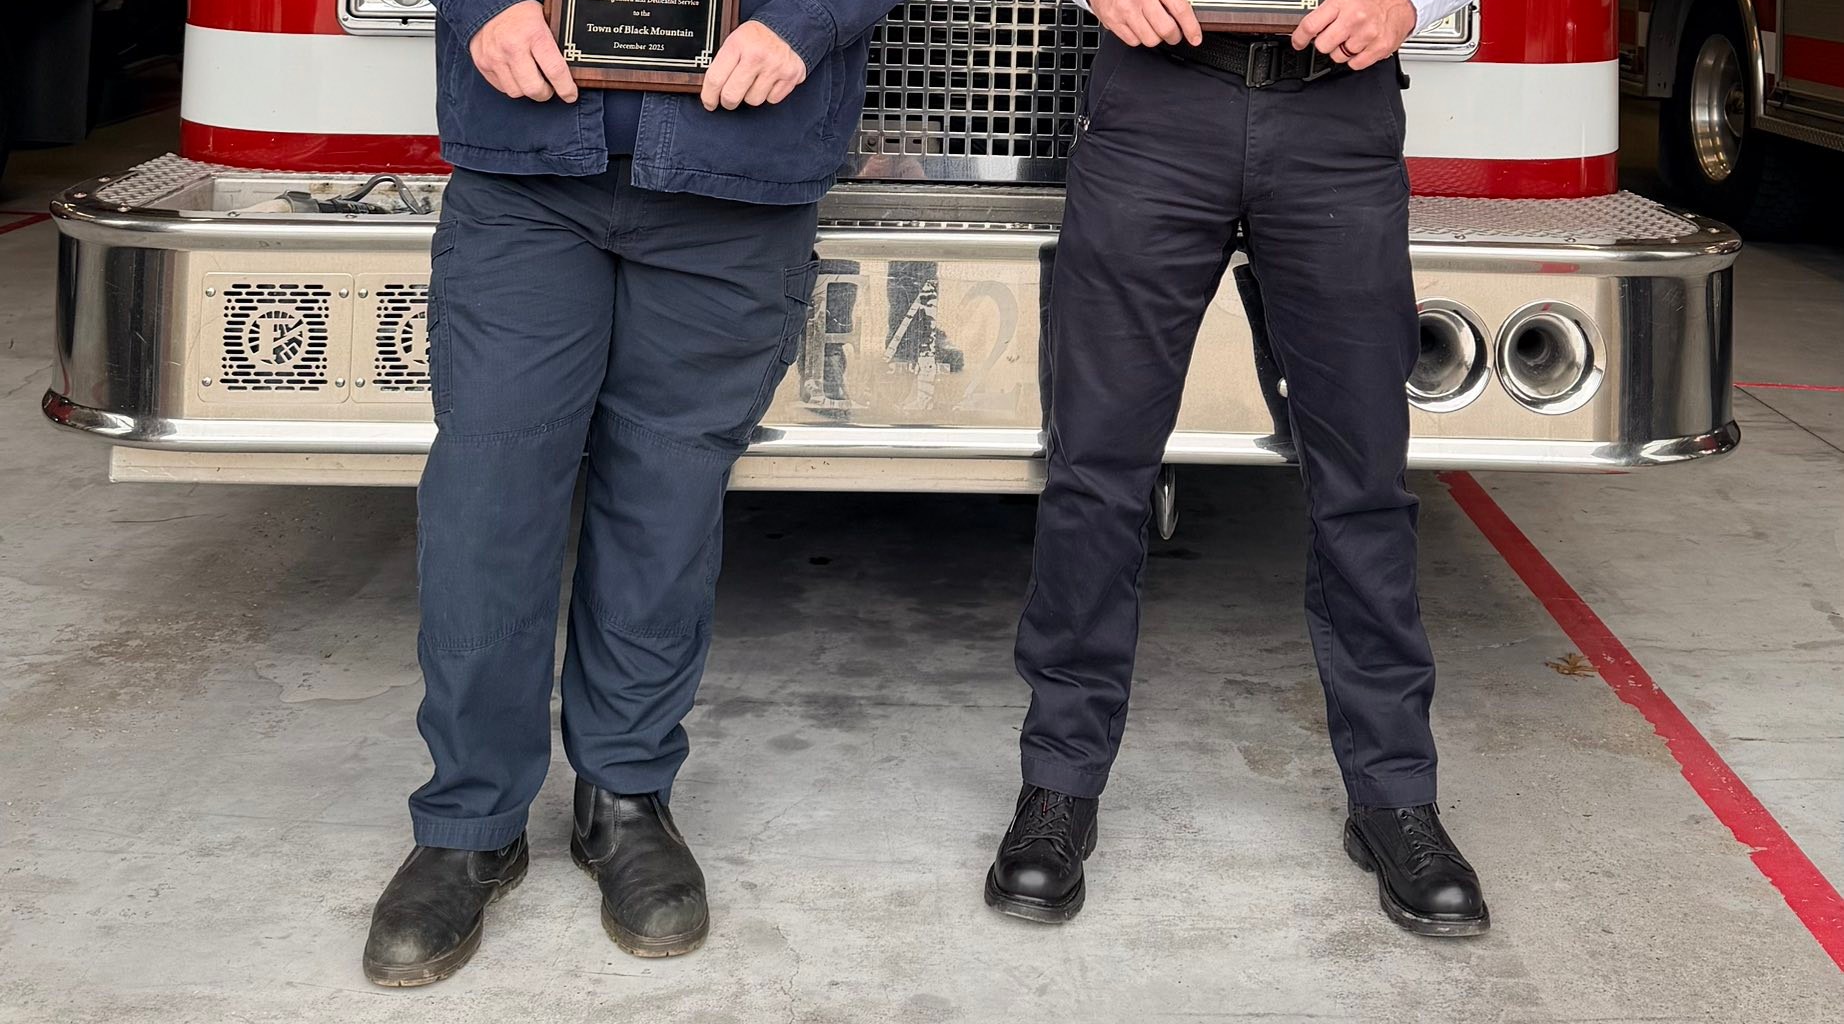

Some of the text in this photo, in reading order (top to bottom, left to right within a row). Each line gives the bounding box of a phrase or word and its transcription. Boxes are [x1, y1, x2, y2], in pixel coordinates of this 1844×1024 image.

[586, 24, 694, 37] Town of Black Mountain
[613, 42, 646, 50] December
